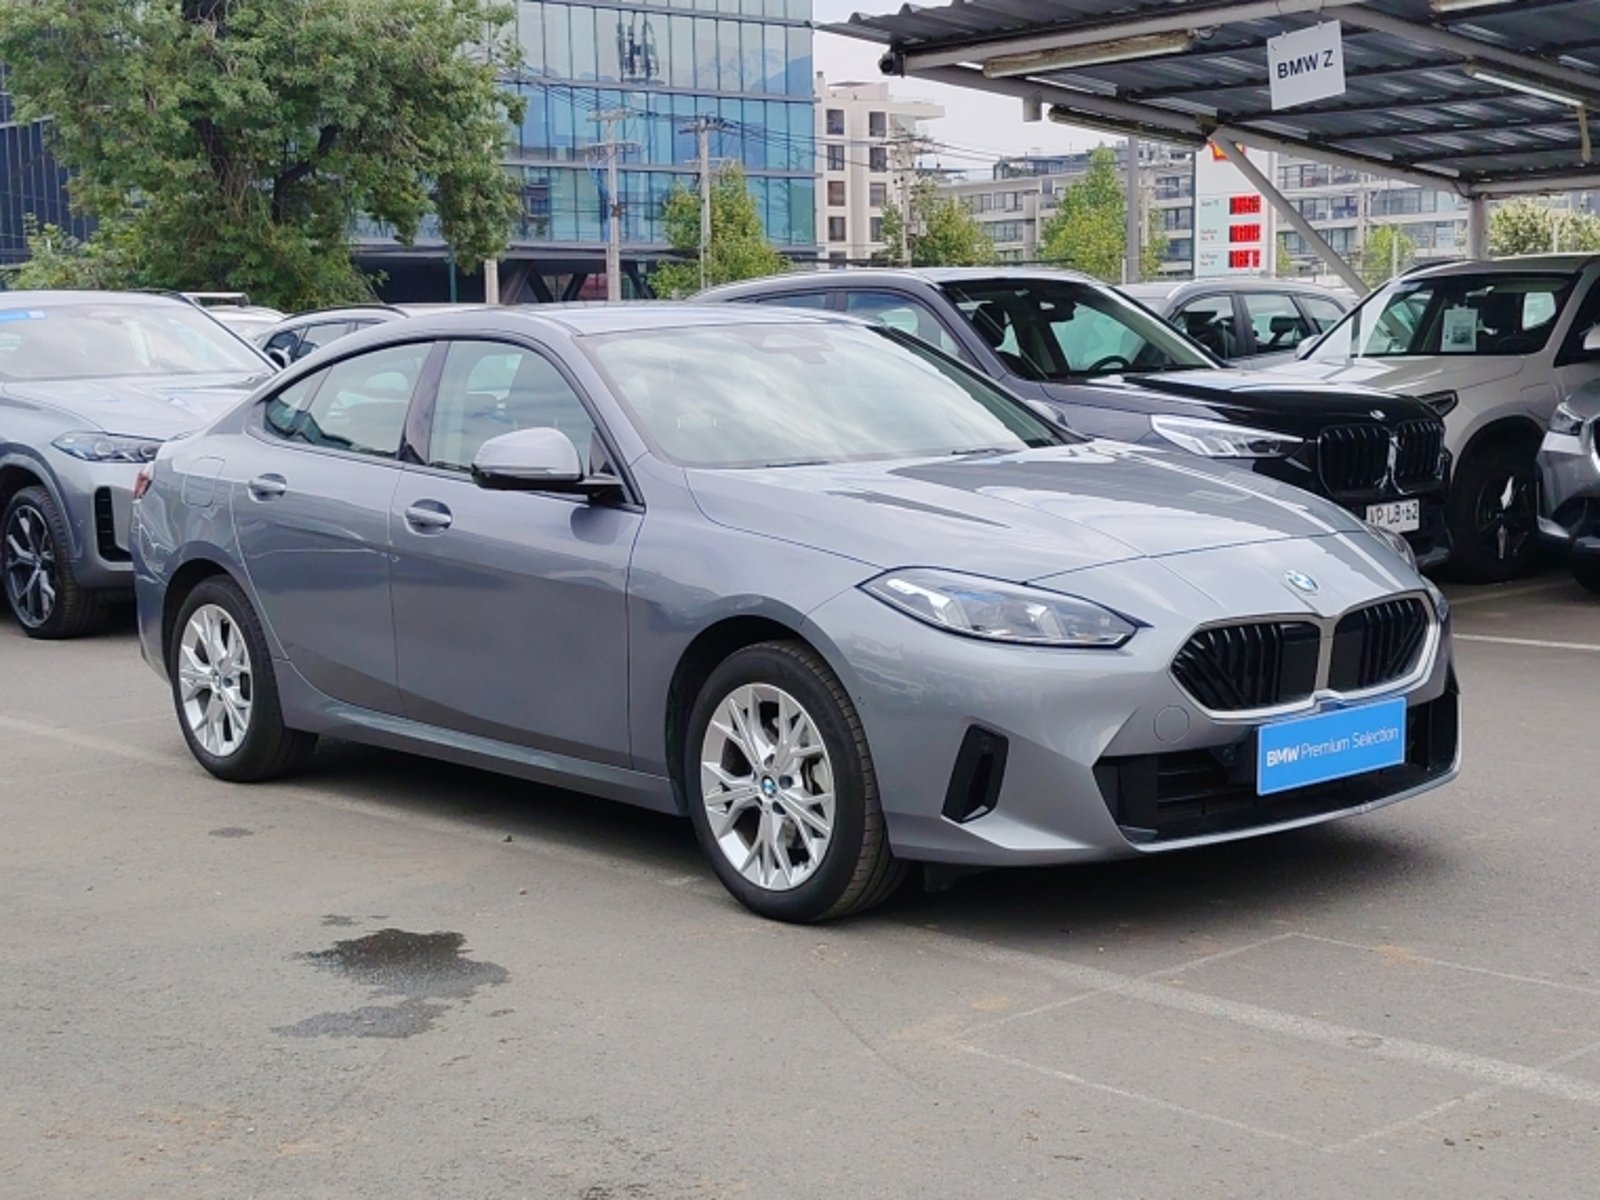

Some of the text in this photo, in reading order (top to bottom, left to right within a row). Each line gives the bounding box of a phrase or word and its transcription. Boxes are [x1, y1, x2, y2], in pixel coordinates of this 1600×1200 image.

[1277, 49, 1334, 79] BMW Z
[1266, 726, 1399, 767] BMW Premium Selection
